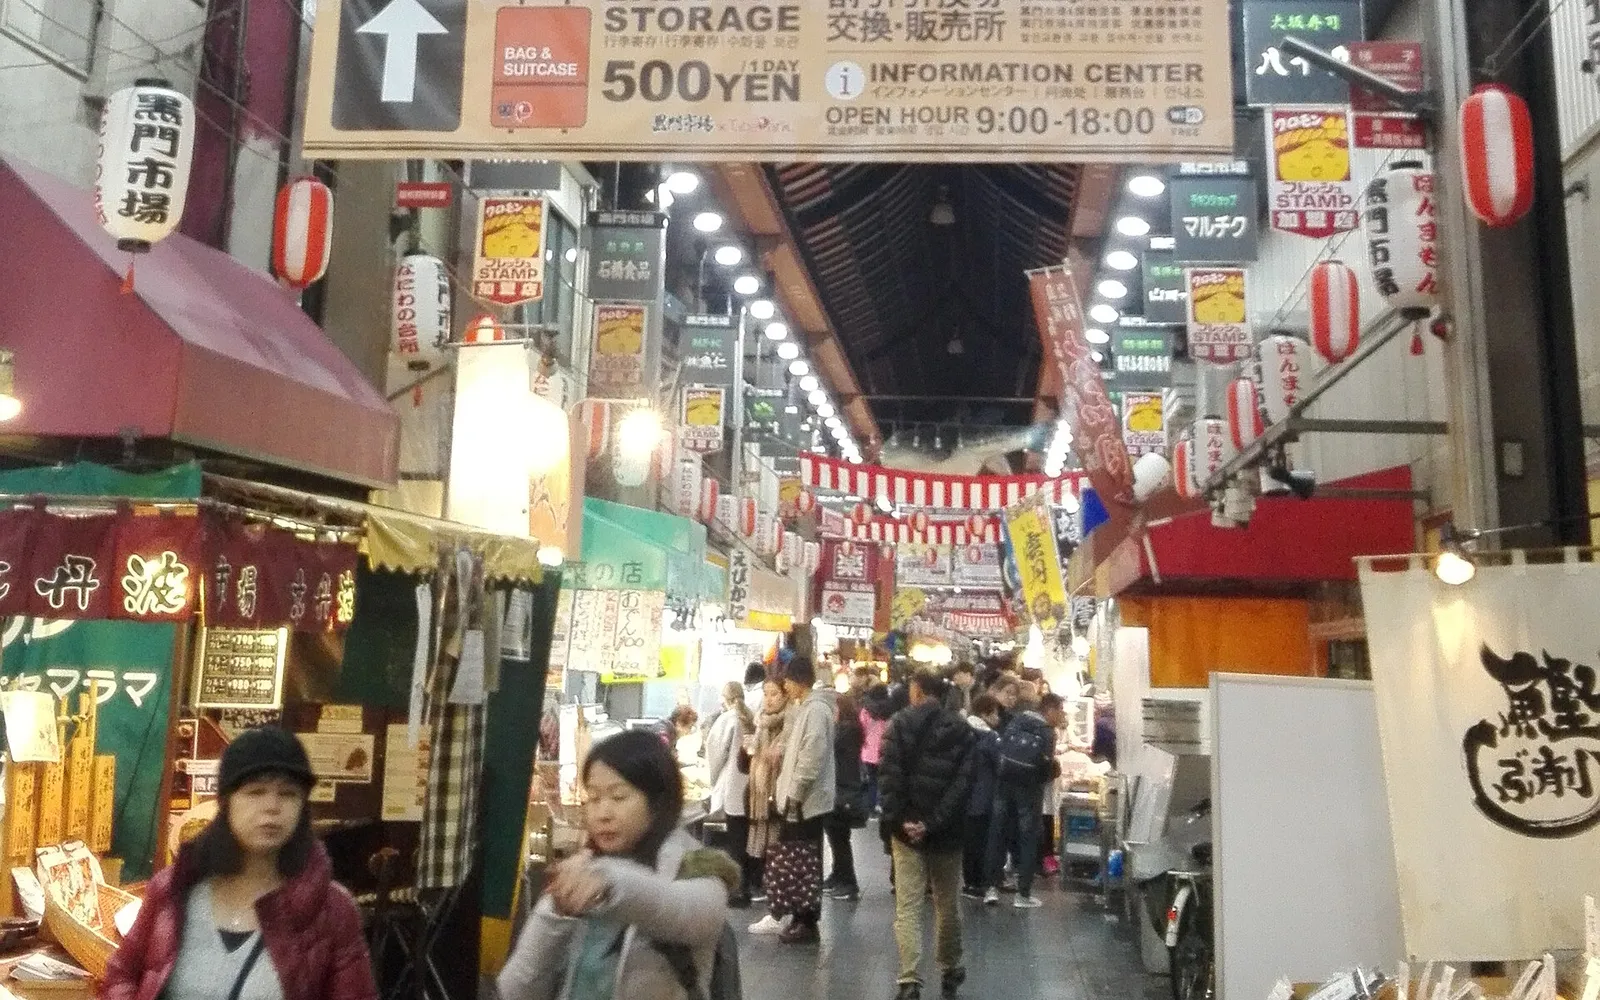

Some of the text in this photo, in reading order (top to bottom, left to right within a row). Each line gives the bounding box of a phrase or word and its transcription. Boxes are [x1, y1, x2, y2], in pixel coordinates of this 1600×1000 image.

[603, 6, 801, 32] STORAGE
[826, 11, 1006, 42] 交換・販売所
[504, 47, 552, 60] BAG &
[503, 63, 578, 77] SUITCASE
[870, 63, 1204, 82] INFORMATION CENTER
[602, 60, 801, 101] 500 YEN
[826, 106, 891, 125] OPEN
[901, 106, 969, 124] HOUR
[976, 106, 1154, 135] 9:00-18:00
[1275, 194, 1352, 208] STAMP
[1182, 214, 1247, 238] マルチク
[480, 268, 538, 279] STAMP
[1191, 332, 1248, 344] STAMP
